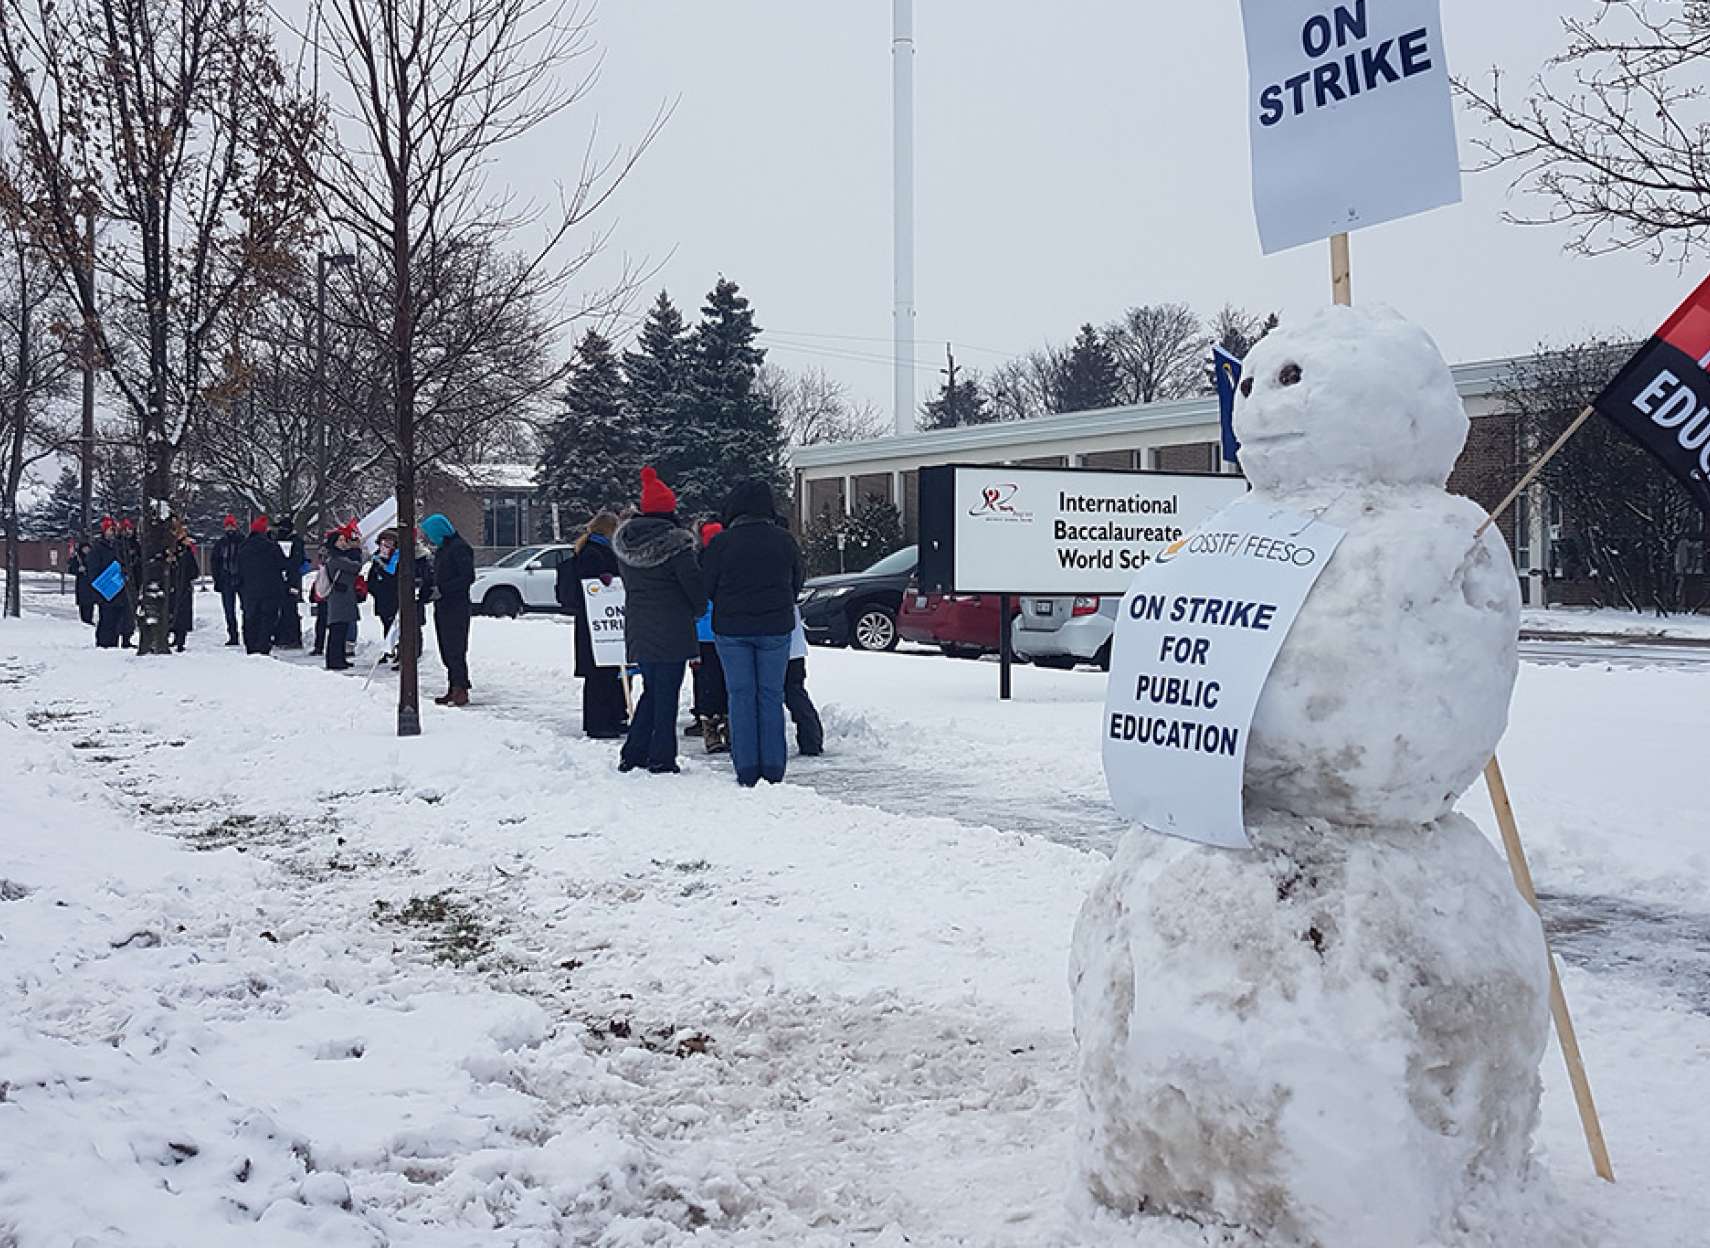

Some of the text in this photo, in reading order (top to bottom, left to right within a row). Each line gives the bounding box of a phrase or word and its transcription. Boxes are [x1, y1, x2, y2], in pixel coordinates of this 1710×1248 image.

[1302, 0, 1367, 58] ON
[1258, 27, 1432, 127] STRIKE
[1060, 491, 1178, 514] International
[1054, 519, 1182, 541] Baccalaureate
[1058, 547, 1113, 569] World
[1189, 533, 1315, 566] OSSTF/FEESO
[604, 605, 625, 618] ON
[1130, 594, 1277, 630] ON STRIKE
[1160, 635, 1210, 665] FOR
[1136, 675, 1220, 709] PUBLIC
[1110, 712, 1239, 756] EDUCATION
